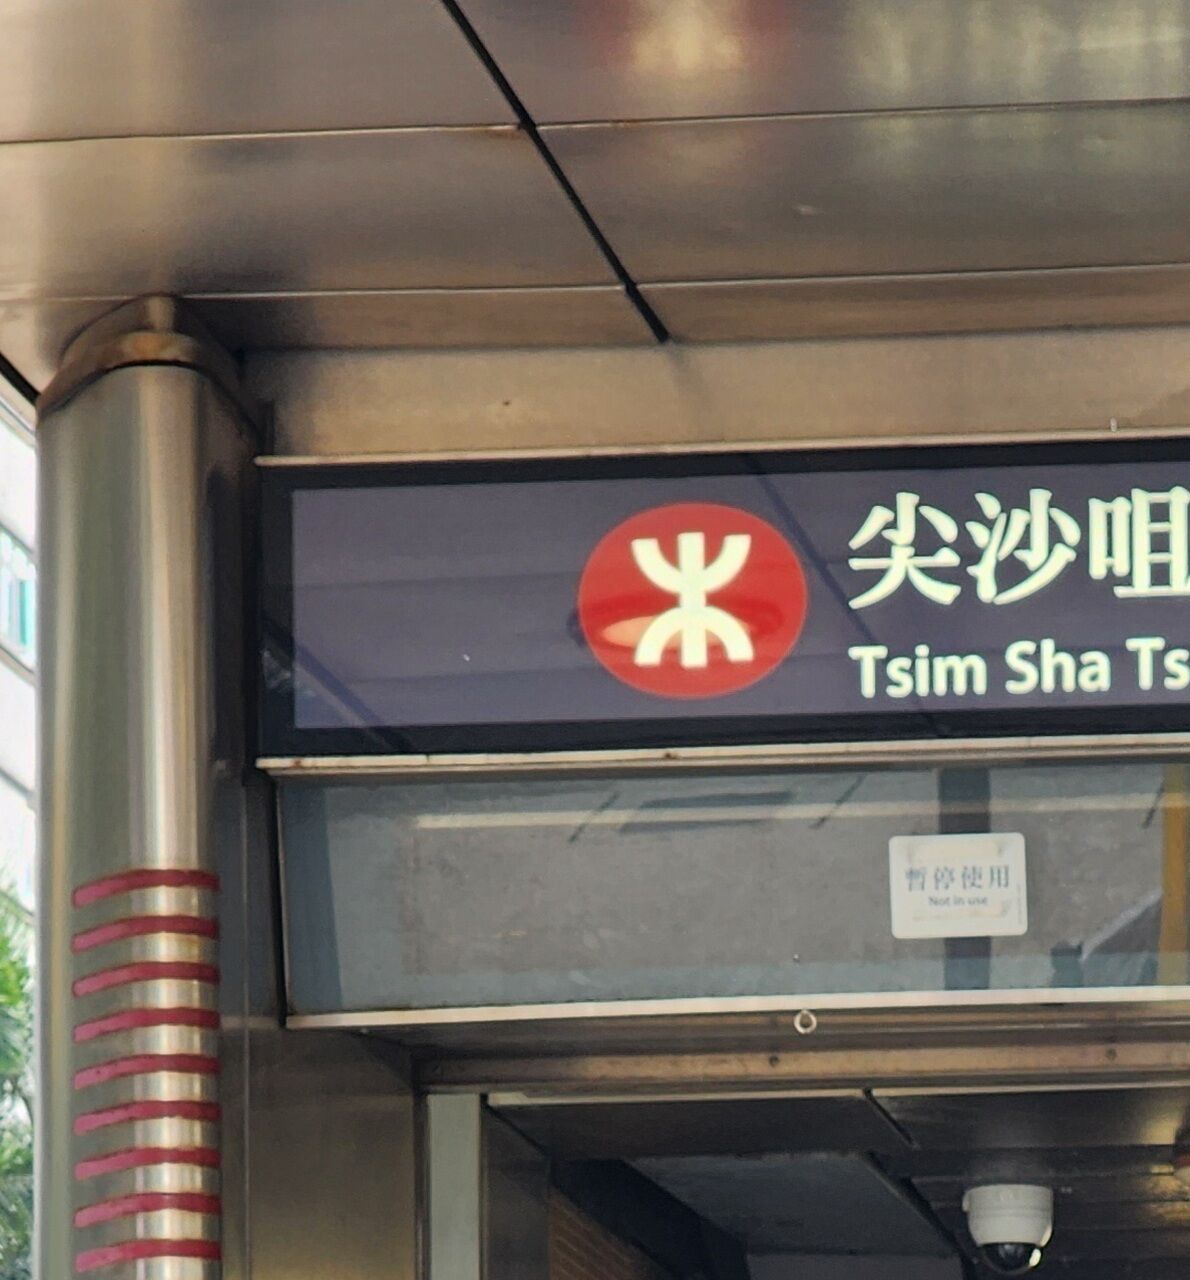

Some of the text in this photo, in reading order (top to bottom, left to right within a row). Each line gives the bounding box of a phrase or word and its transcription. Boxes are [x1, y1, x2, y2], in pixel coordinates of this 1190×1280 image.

[848, 644, 987, 698] Tsim
[1005, 637, 1111, 695] Sha
[905, 864, 1009, 892] 暫停使用
[928, 896, 988, 906] Not in use
